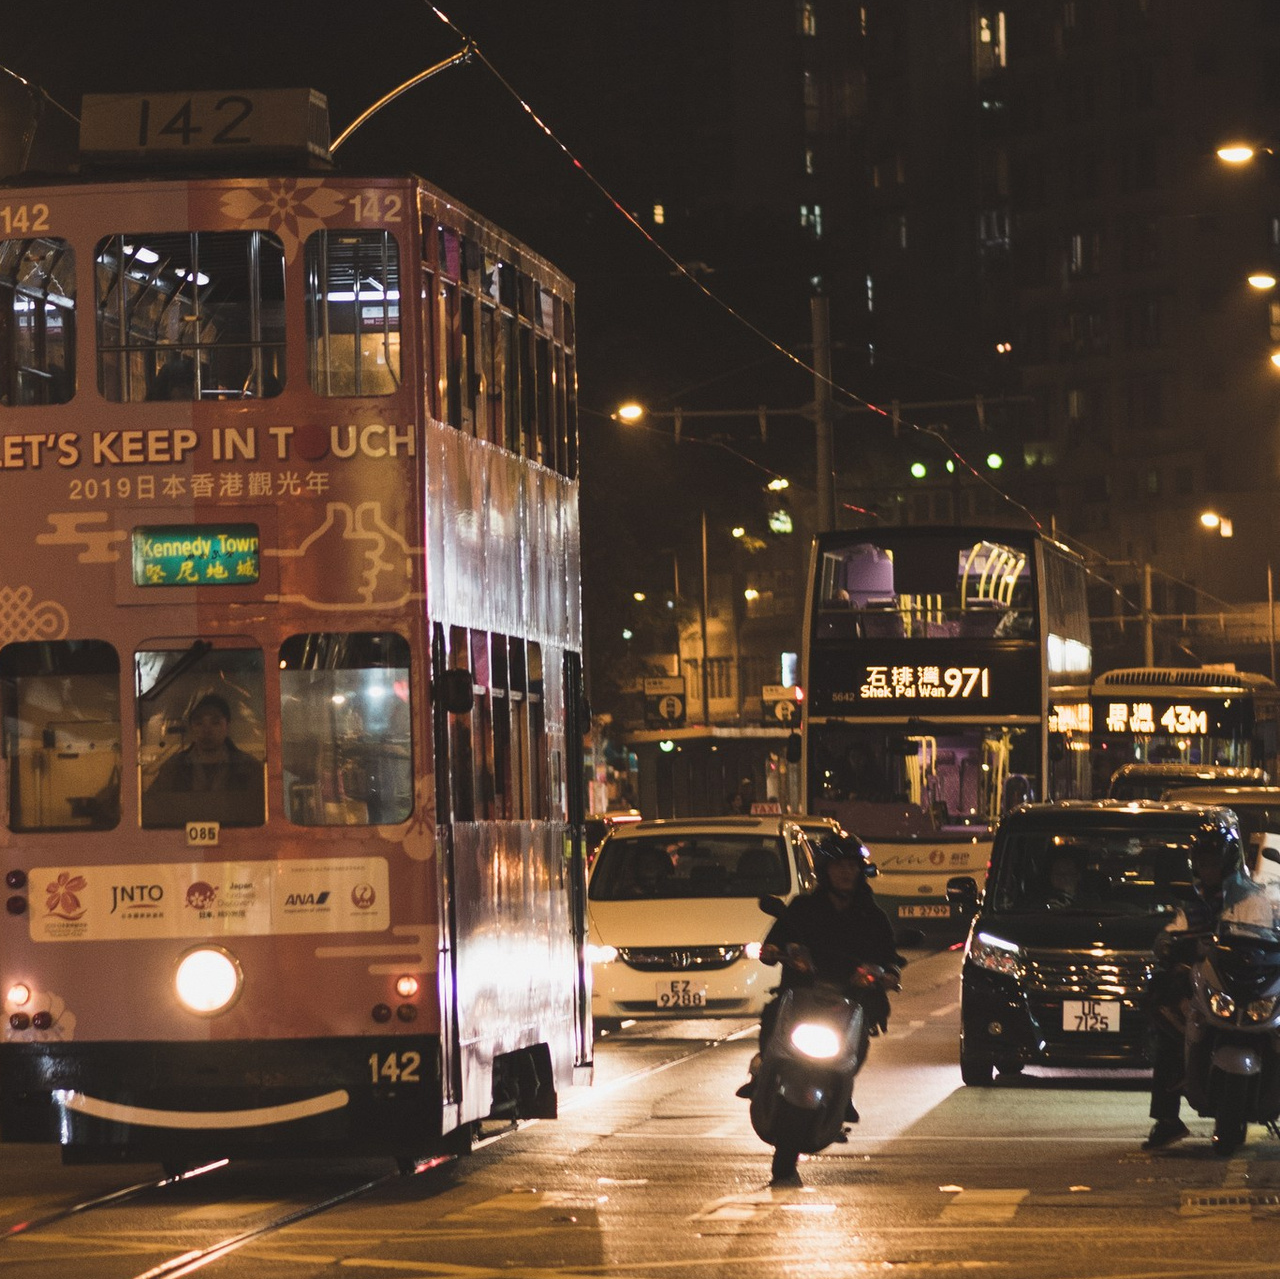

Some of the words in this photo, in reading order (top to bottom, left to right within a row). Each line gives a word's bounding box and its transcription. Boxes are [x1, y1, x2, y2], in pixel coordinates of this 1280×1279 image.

[138, 95, 254, 147] 142
[0, 203, 50, 234] 142
[349, 195, 403, 224] 142
[92, 429, 198, 465] KEEP
[211, 427, 256, 461] IN
[69, 470, 331, 501] 2019日本香港觀光年
[142, 535, 212, 559] Kennedy
[217, 534, 259, 554] Town
[865, 666, 941, 687] 石排灣
[943, 667, 990, 698] 971
[860, 685, 893, 698] Shek
[895, 685, 917, 698] Pai
[919, 685, 946, 698] Wan
[1160, 705, 1208, 734] 43M
[110, 884, 164, 915] JNTO
[285, 893, 315, 905] ANA
[660, 992, 702, 1008] 9288
[670, 980, 691, 993] EZ
[1081, 1000, 1102, 1016] UC
[1074, 1015, 1109, 1031] 7125
[368, 1051, 421, 1083] 142
